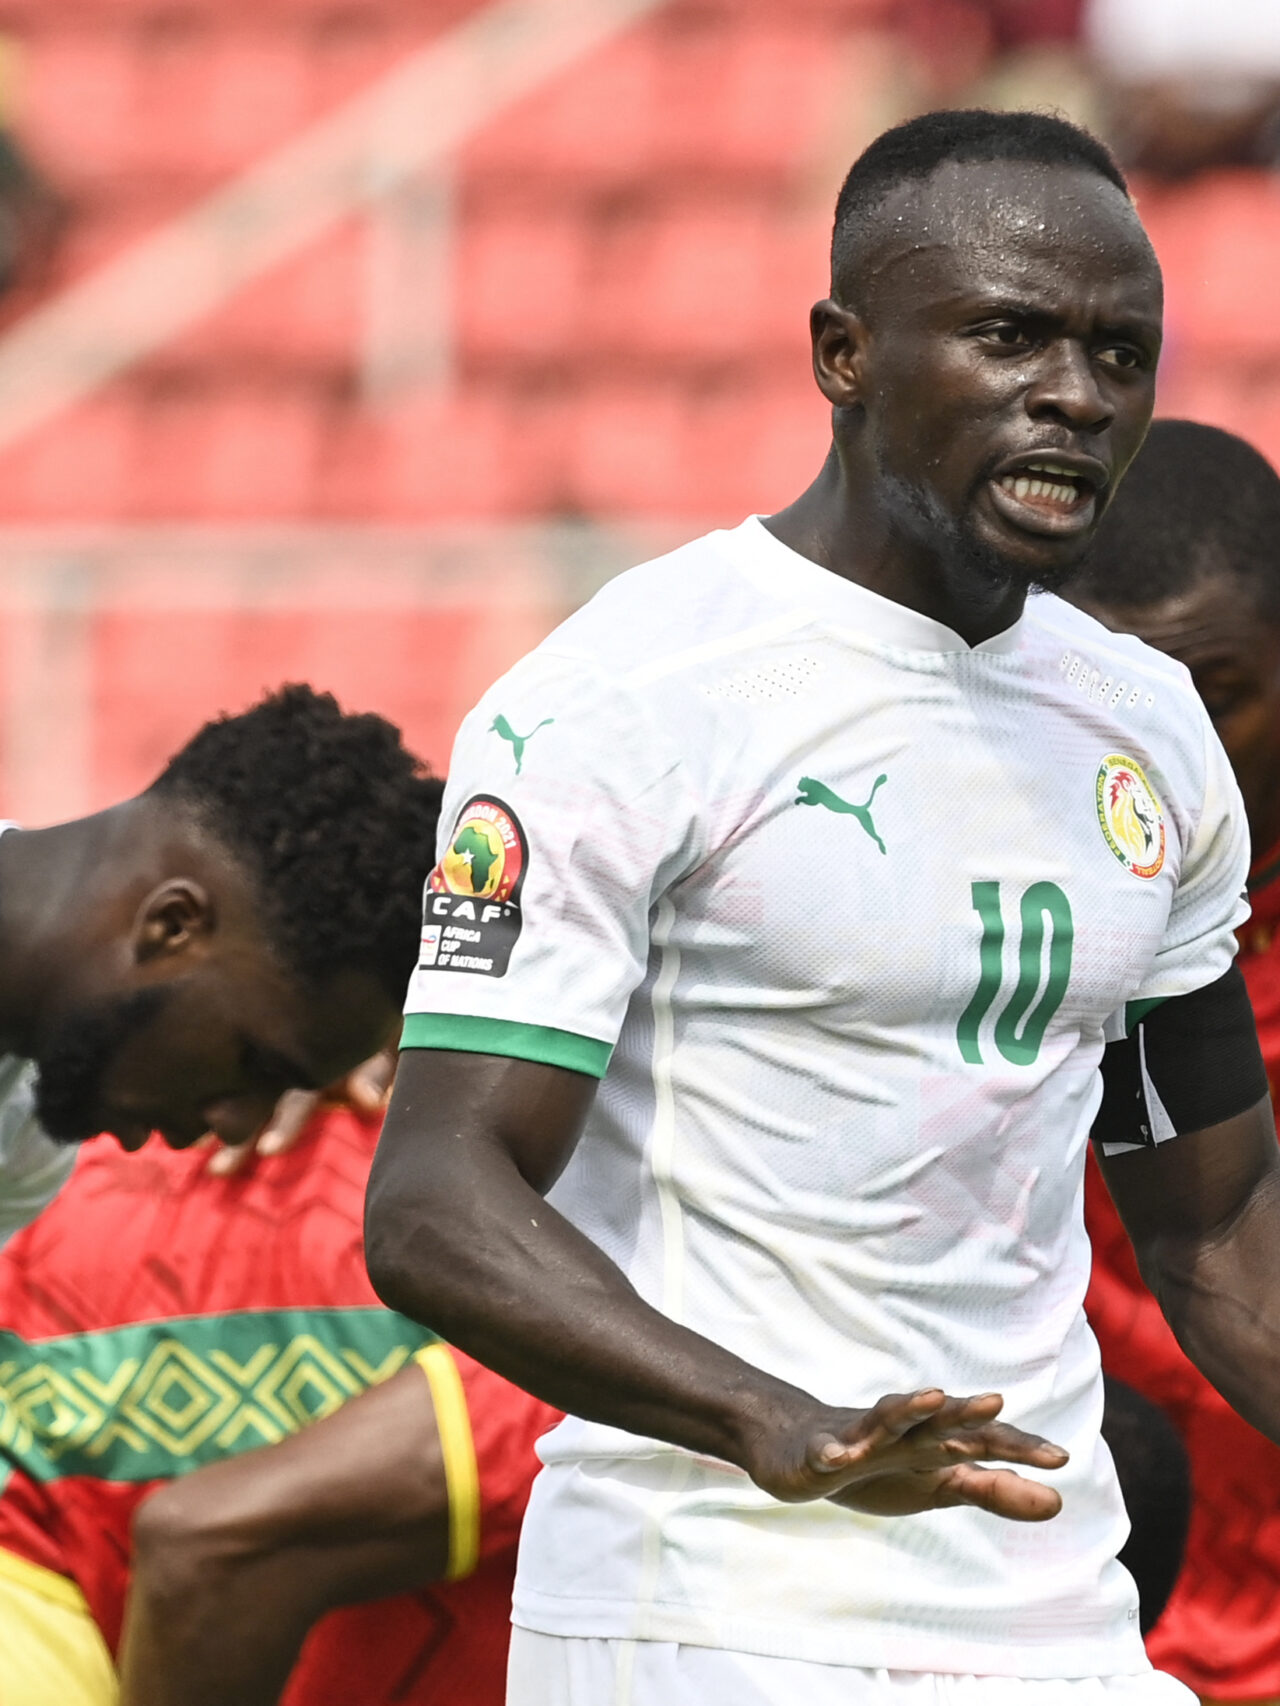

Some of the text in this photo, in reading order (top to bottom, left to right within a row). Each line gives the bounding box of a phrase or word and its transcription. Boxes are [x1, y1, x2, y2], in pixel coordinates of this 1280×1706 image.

[496, 817, 517, 849] 2021
[432, 896, 501, 923] CAF
[442, 925, 482, 943] AFRICA
[440, 939, 461, 953] CUP
[437, 953, 494, 971] OF NATIONS
[956, 880, 1074, 1066] 10
